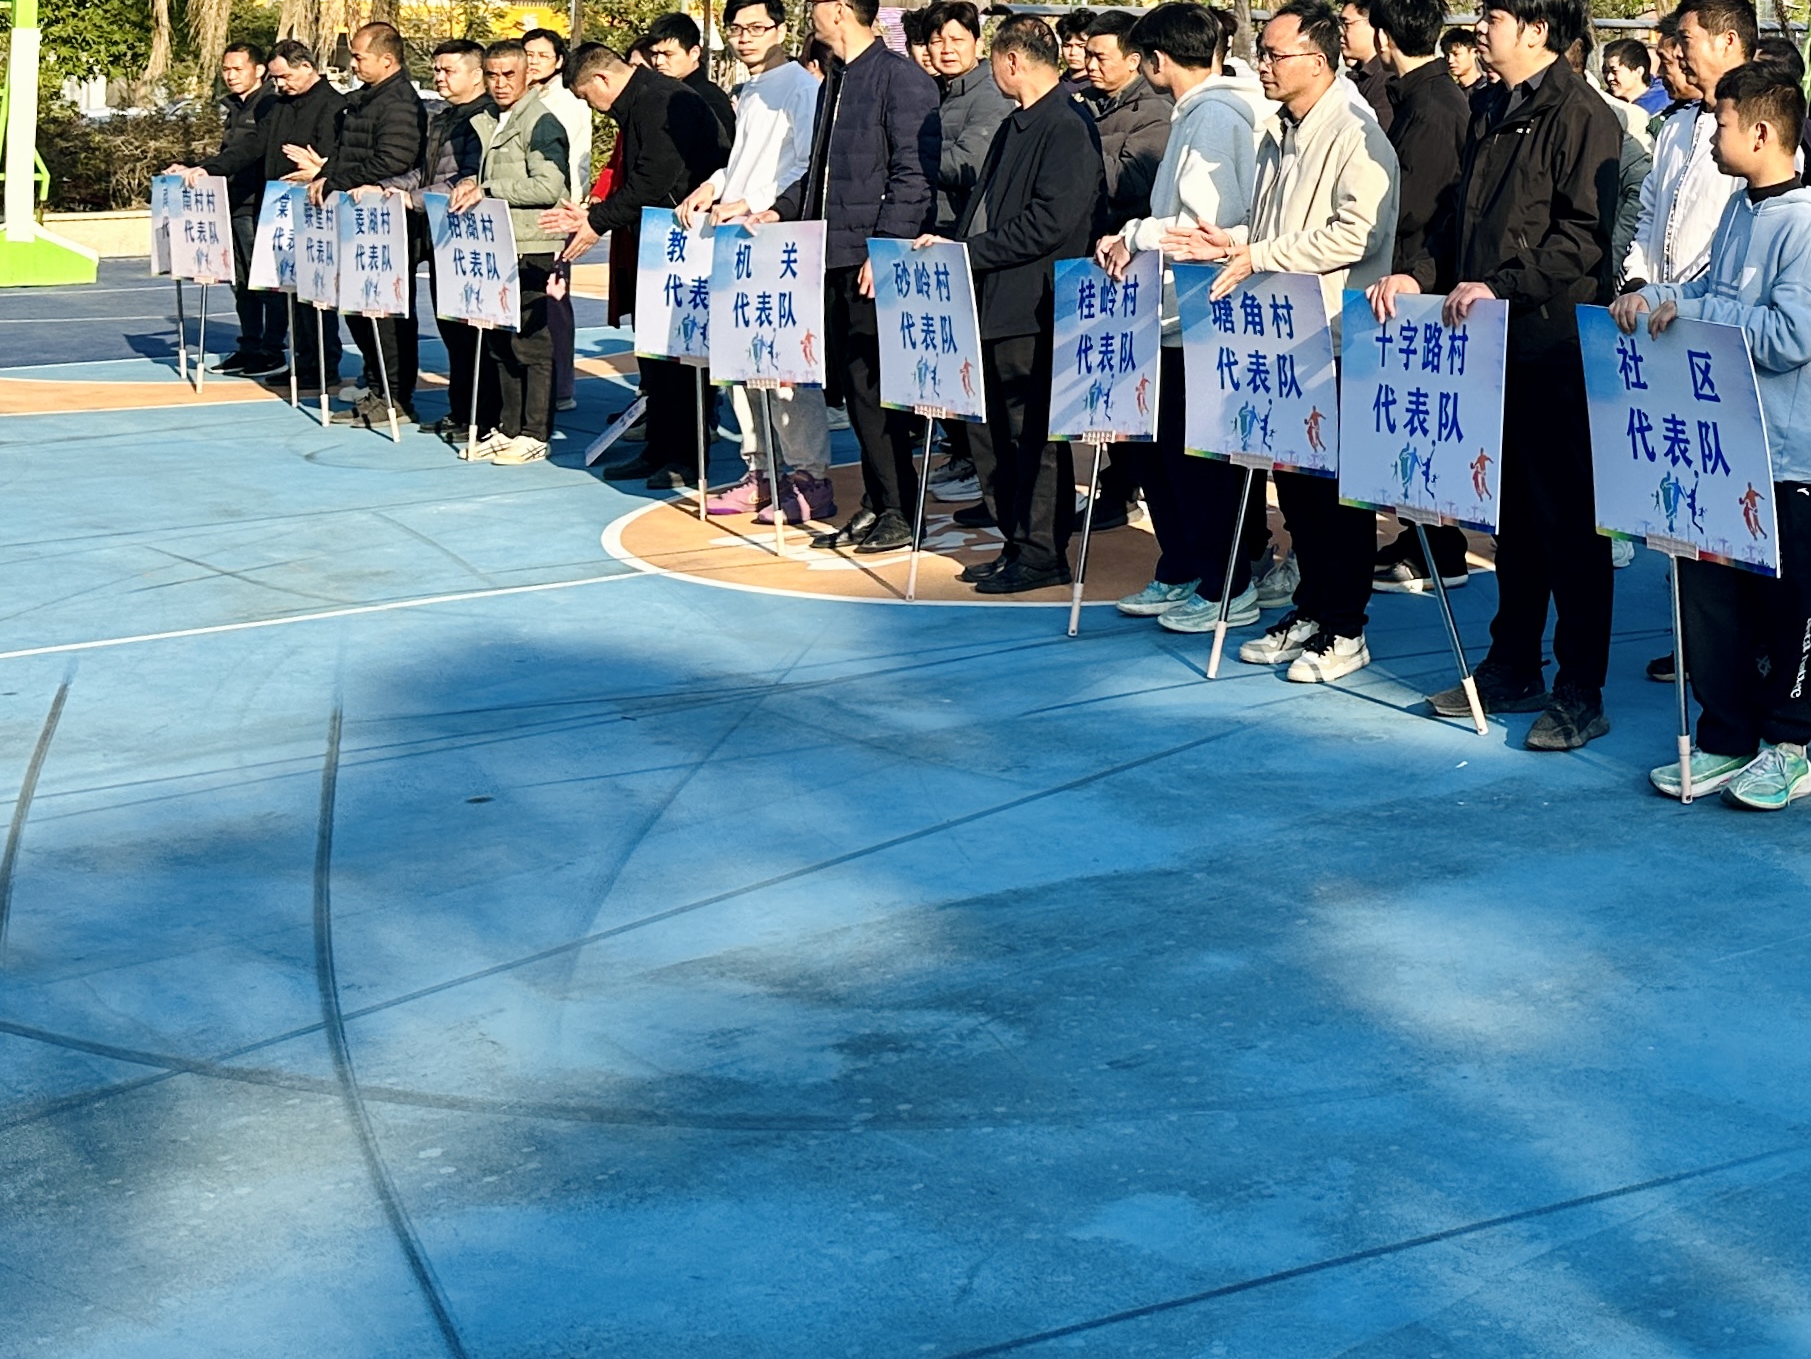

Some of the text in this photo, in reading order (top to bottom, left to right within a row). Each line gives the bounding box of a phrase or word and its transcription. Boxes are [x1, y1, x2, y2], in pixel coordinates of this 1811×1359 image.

[184, 219, 219, 245] 代表队
[306, 237, 335, 267] 代表队
[666, 227, 688, 264] 教
[355, 243, 393, 273] 代表队
[452, 246, 502, 282] 代表队
[734, 241, 799, 281] 机关
[892, 259, 951, 303] 砂岭村
[1077, 273, 1140, 321] 桂岭村
[733, 290, 798, 330] 代表队
[899, 310, 959, 355] 代表队
[1210, 290, 1295, 340] 塘角村
[1075, 331, 1137, 376] 代表队
[1375, 318, 1470, 376] 十字路村
[1216, 346, 1304, 400] 代表队
[1615, 336, 1722, 404] 社区
[1372, 382, 1465, 444] 代表队
[1626, 406, 1732, 478] 代表队
